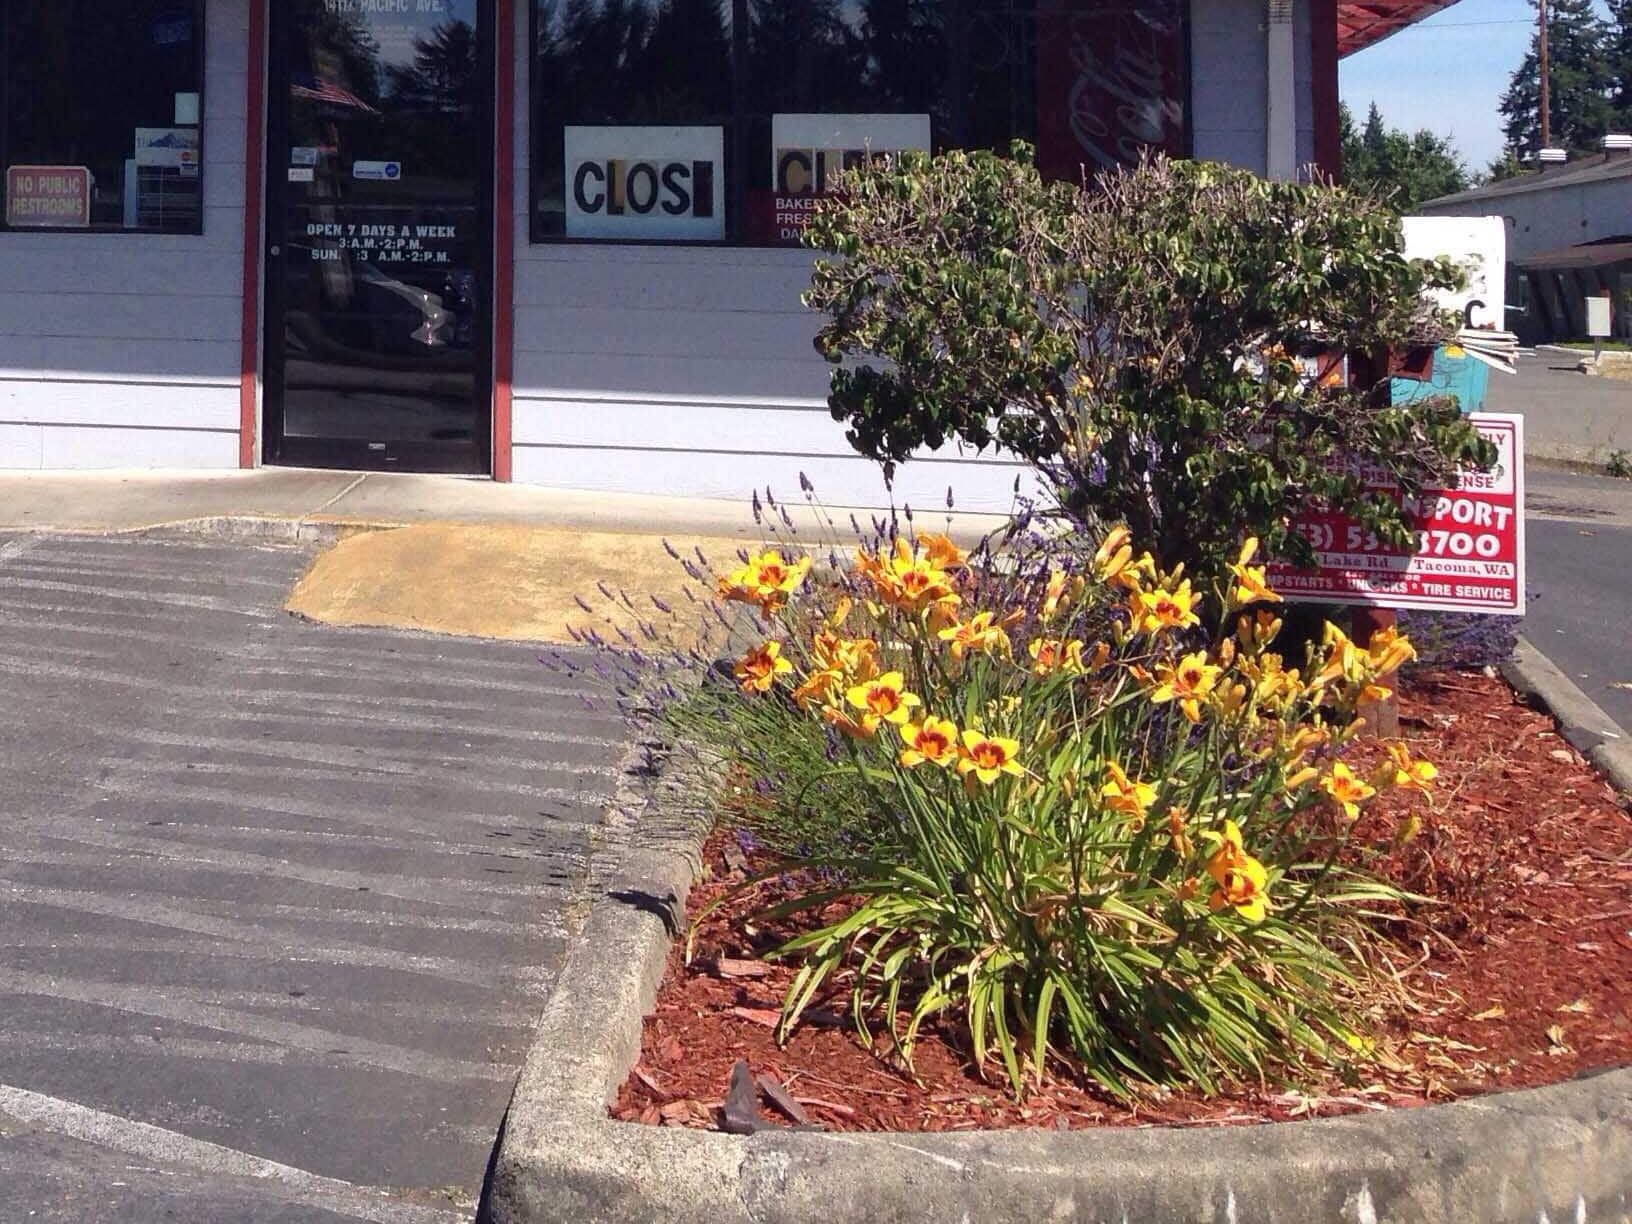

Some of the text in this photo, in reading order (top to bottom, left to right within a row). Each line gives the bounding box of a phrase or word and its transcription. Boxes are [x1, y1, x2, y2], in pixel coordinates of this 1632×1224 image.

[16, 175, 81, 193] NO PUBLIC
[12, 197, 83, 216] RESTROOMS
[776, 213, 817, 225] FRES
[306, 223, 456, 238] OPEN 7 DAYS A WEEK
[1321, 555, 1511, 576] Lake Rd Tacoma, WA
[1348, 578, 1409, 594] UNLCKS
[1421, 583, 1451, 597] TIRE
[1456, 584, 1512, 600] SERVICE
